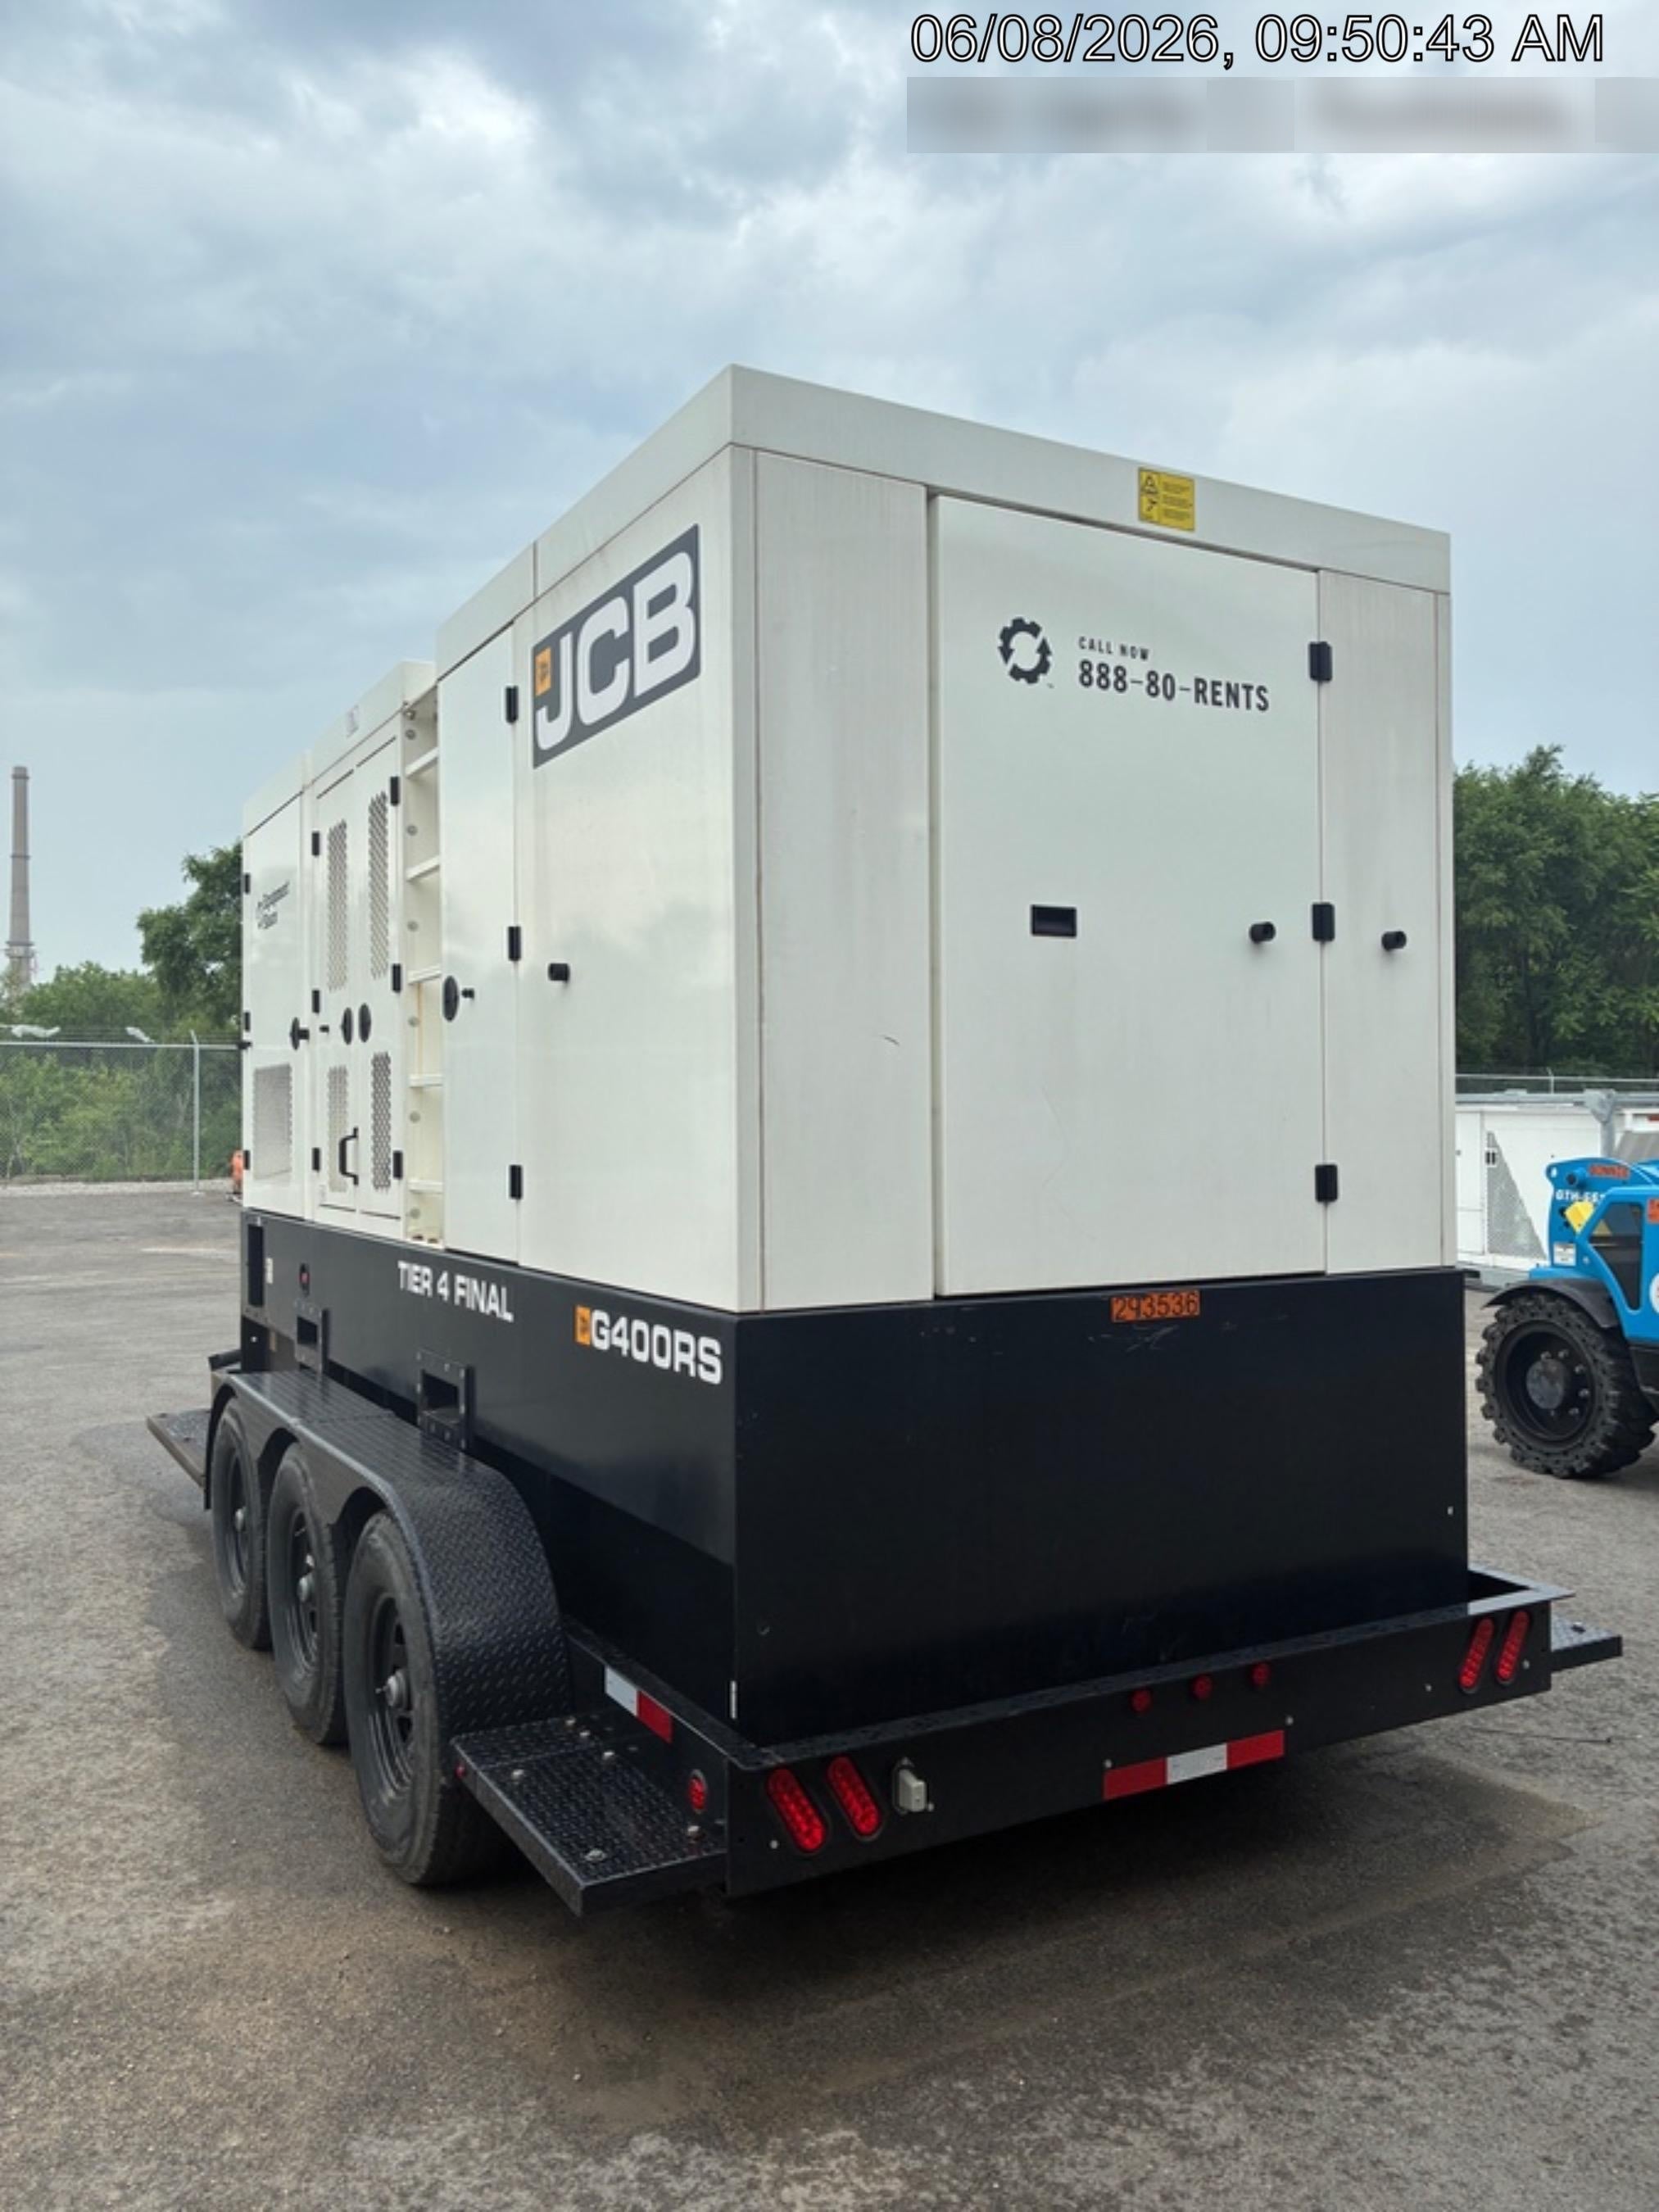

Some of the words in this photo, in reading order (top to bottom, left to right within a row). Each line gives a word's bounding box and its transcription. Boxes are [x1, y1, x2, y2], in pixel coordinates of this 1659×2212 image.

[536, 551, 696, 750] JCB
[1078, 636, 1113, 655] CALL
[1120, 643, 1149, 661] NOW
[1078, 659, 1270, 712] 888-80-RENTS
[397, 1260, 433, 1298] TIER
[437, 1271, 450, 1302] 4
[454, 1274, 514, 1323] FINAL
[591, 1309, 723, 1385] G400RS
